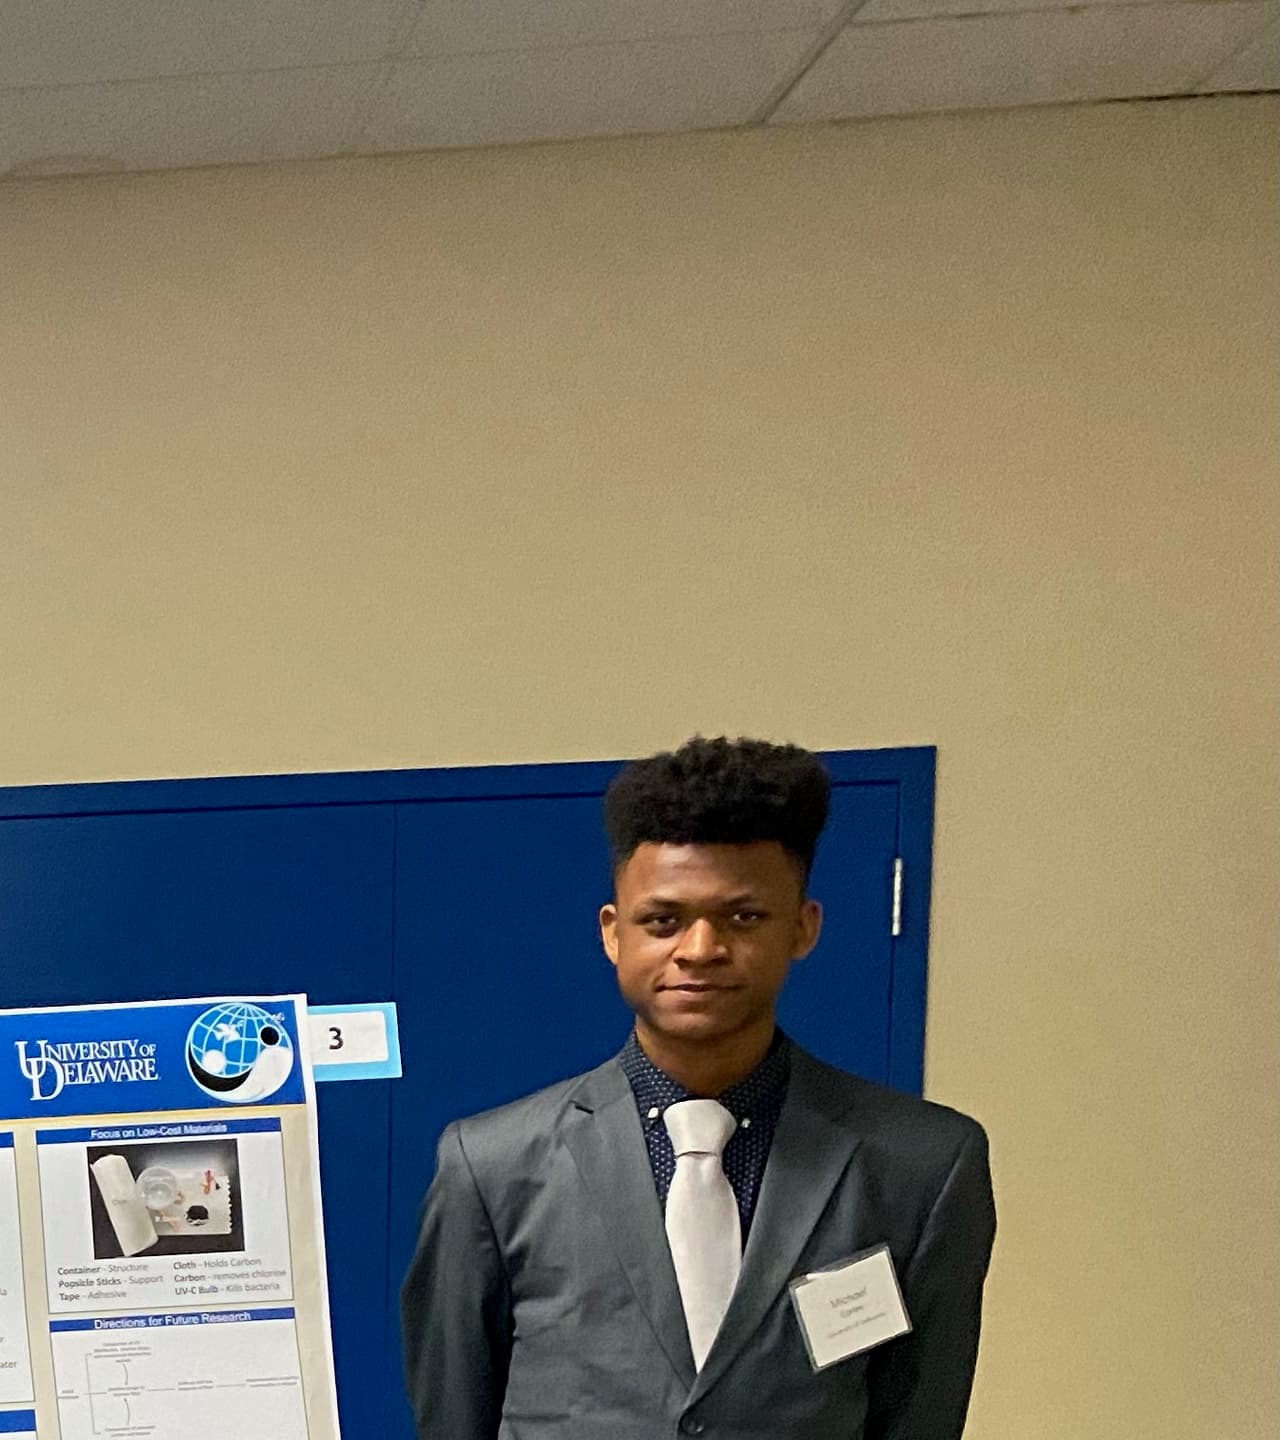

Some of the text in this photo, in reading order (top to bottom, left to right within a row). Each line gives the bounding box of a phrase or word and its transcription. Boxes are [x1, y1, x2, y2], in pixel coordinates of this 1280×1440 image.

[329, 1027, 343, 1049] 3
[15, 1039, 157, 1079] UNIVERSITY OF
[27, 1057, 159, 1101] DELAWARE
[91, 1123, 228, 1139] Focus on Low-Cost Materials
[93, 1311, 252, 1329] Directions for Future Research
